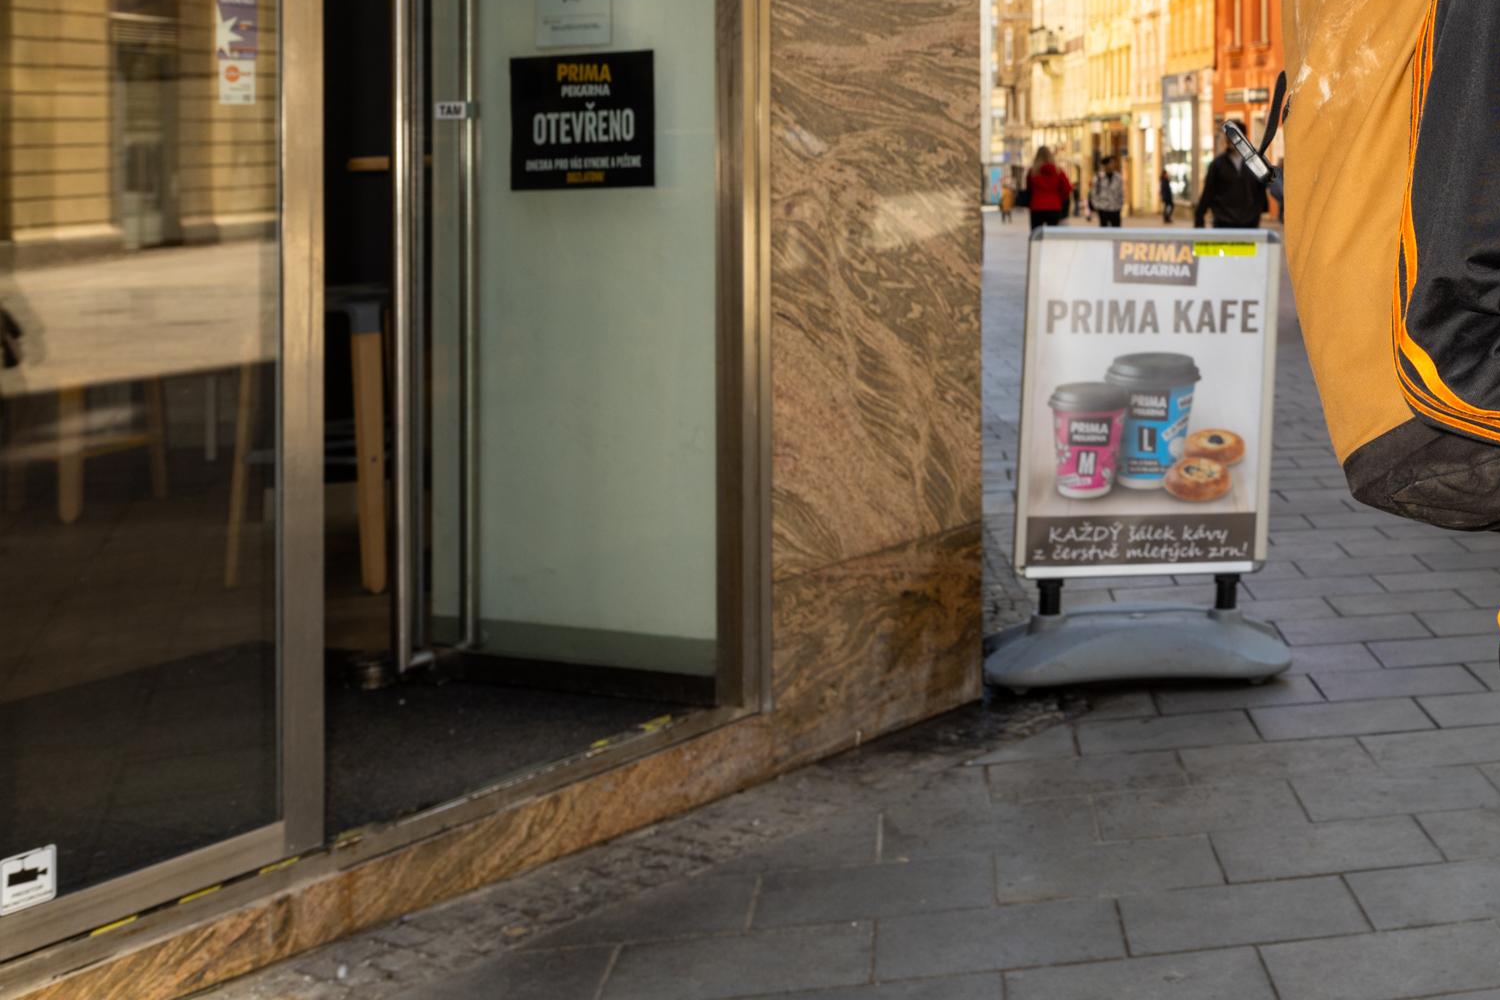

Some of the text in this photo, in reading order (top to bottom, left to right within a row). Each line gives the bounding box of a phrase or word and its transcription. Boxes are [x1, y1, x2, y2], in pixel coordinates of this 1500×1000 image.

[557, 63, 612, 83] PRIMA
[532, 101, 635, 146] OTEVŘENO
[1119, 241, 1194, 265] PRIMA
[1046, 299, 1259, 334] PRIMA KAFE
[1070, 420, 1109, 435] PRIMA
[1142, 428, 1154, 452] L
[1079, 452, 1096, 476] M
[1049, 521, 1229, 543] KAŽDÝ šálek kávy
[1033, 541, 1249, 562] z čerstvě mletých zrn!
